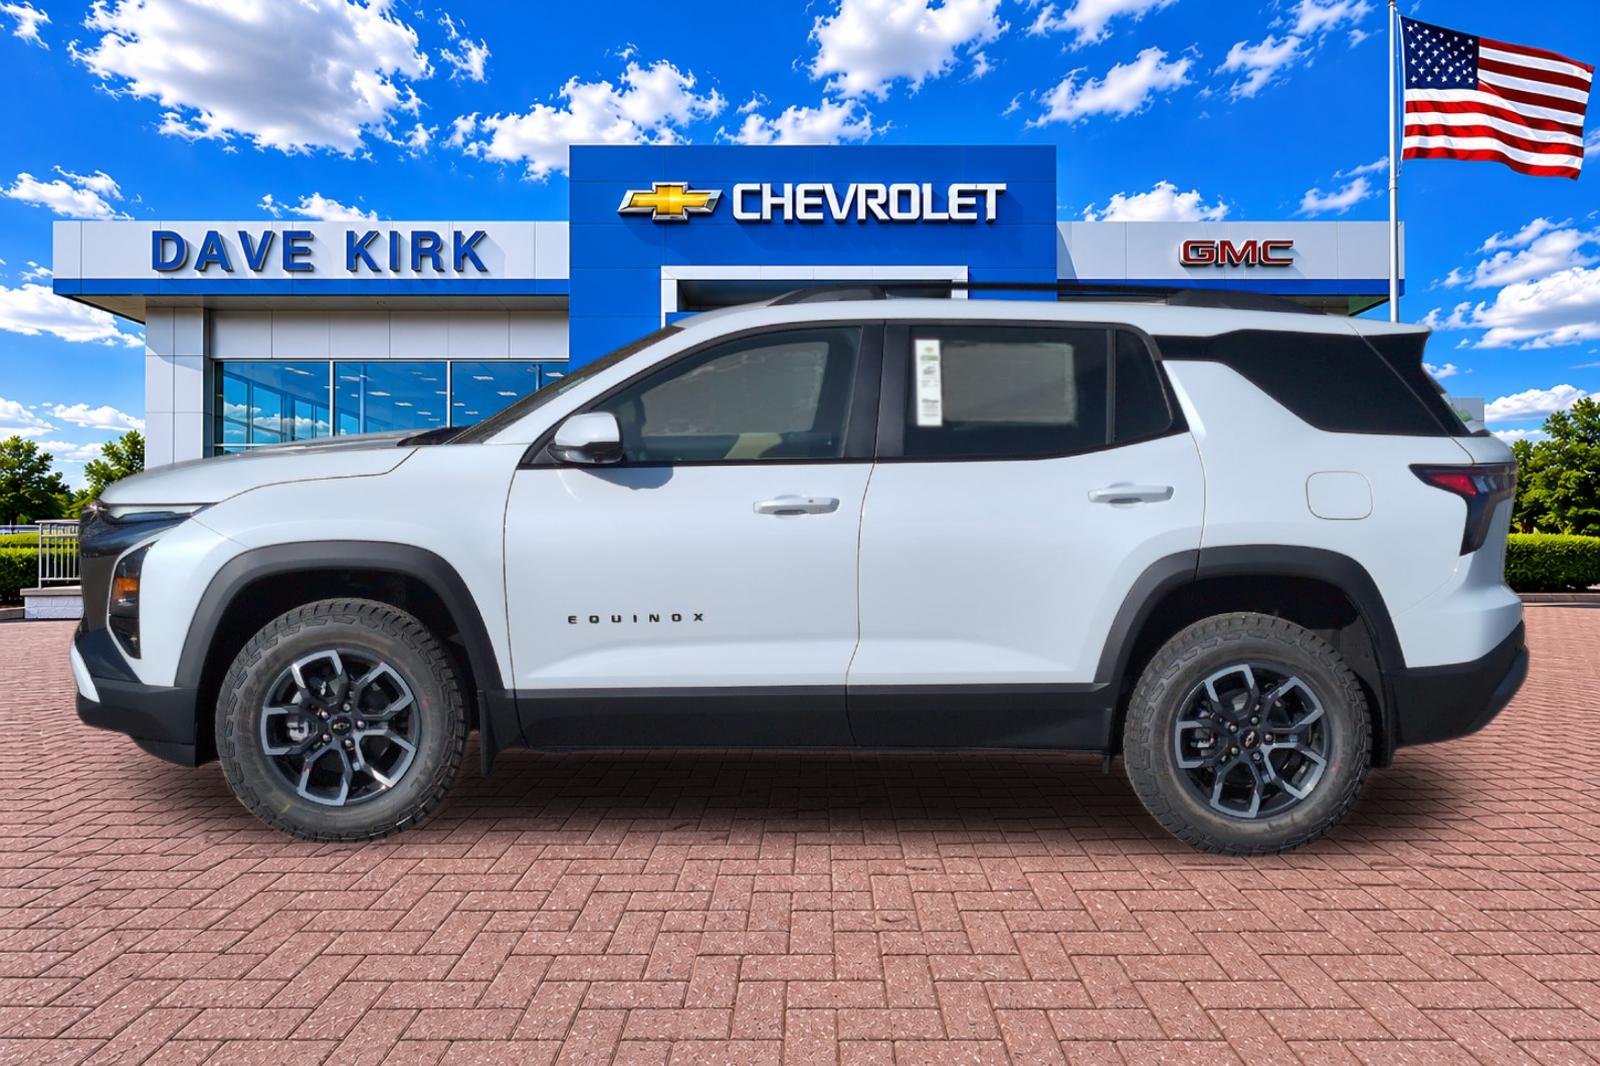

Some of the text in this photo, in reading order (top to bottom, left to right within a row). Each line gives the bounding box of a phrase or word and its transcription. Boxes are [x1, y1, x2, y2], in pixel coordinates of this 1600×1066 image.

[732, 183, 1007, 221] CHEVROLET
[152, 230, 489, 272] DAVE KIRK
[1180, 239, 1294, 267] GMC
[567, 612, 704, 624] EQUINOX
